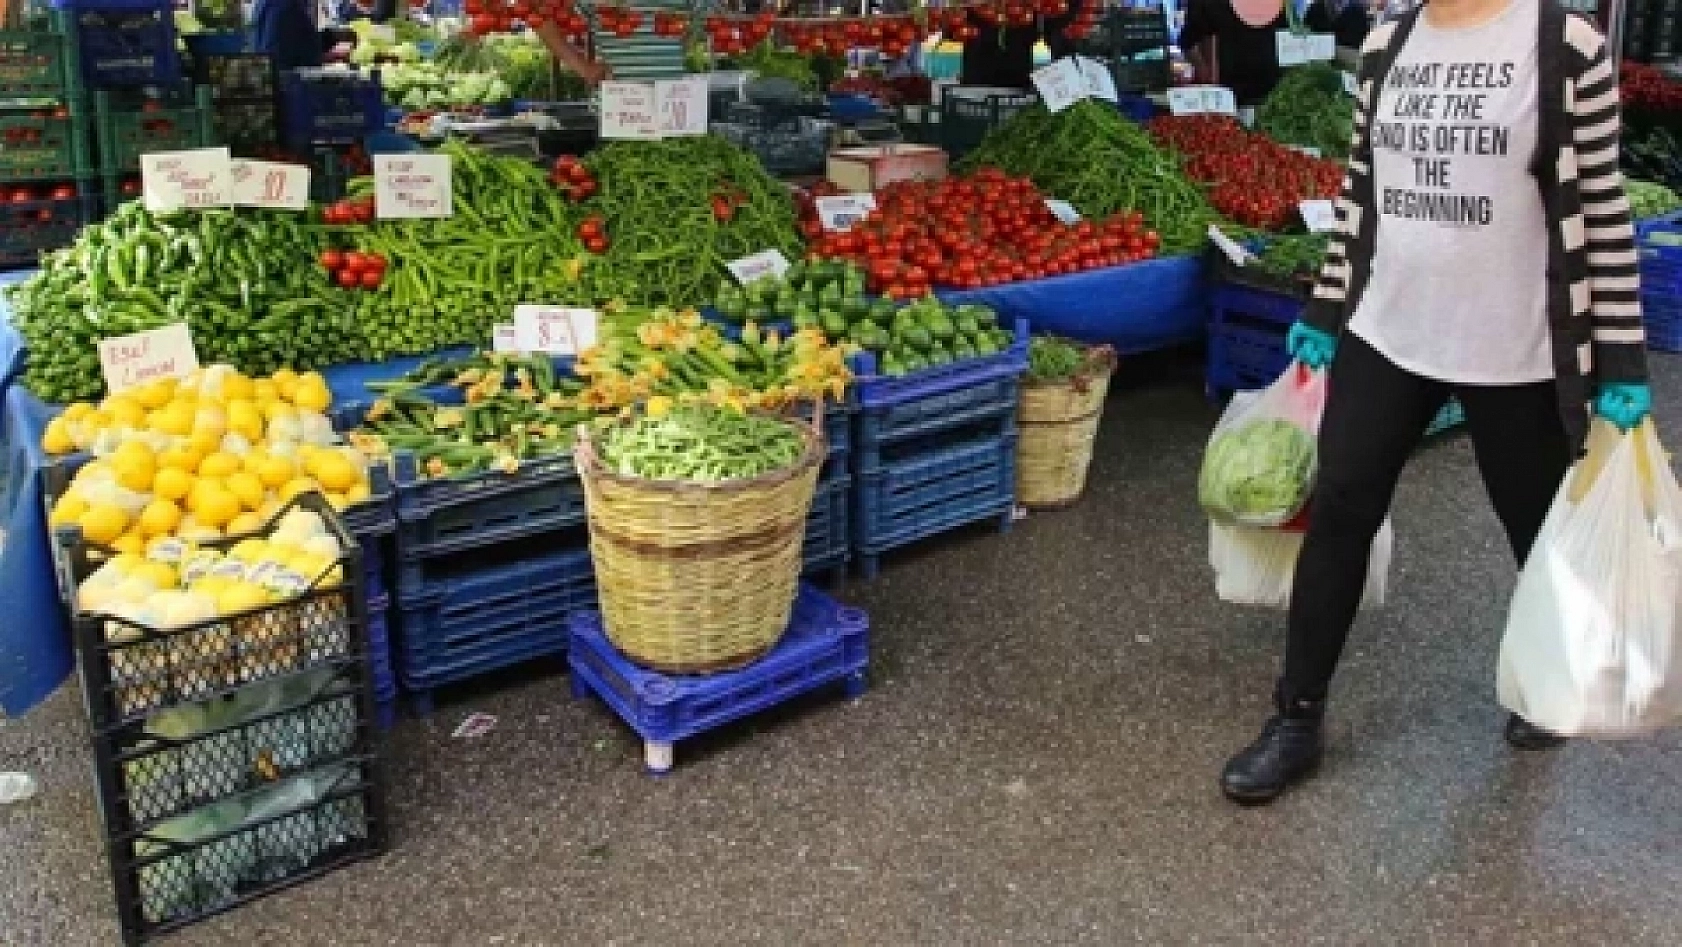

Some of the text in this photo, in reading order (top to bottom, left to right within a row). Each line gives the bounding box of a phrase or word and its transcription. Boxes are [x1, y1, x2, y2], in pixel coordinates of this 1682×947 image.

[1389, 62, 1514, 88] WHAT FEELS
[1395, 94, 1487, 120] LIKE THE
[1411, 125, 1431, 152] IS
[1436, 125, 1509, 156] OFTEN
[1412, 157, 1451, 188] THE
[1383, 186, 1493, 226] BEGINNING
